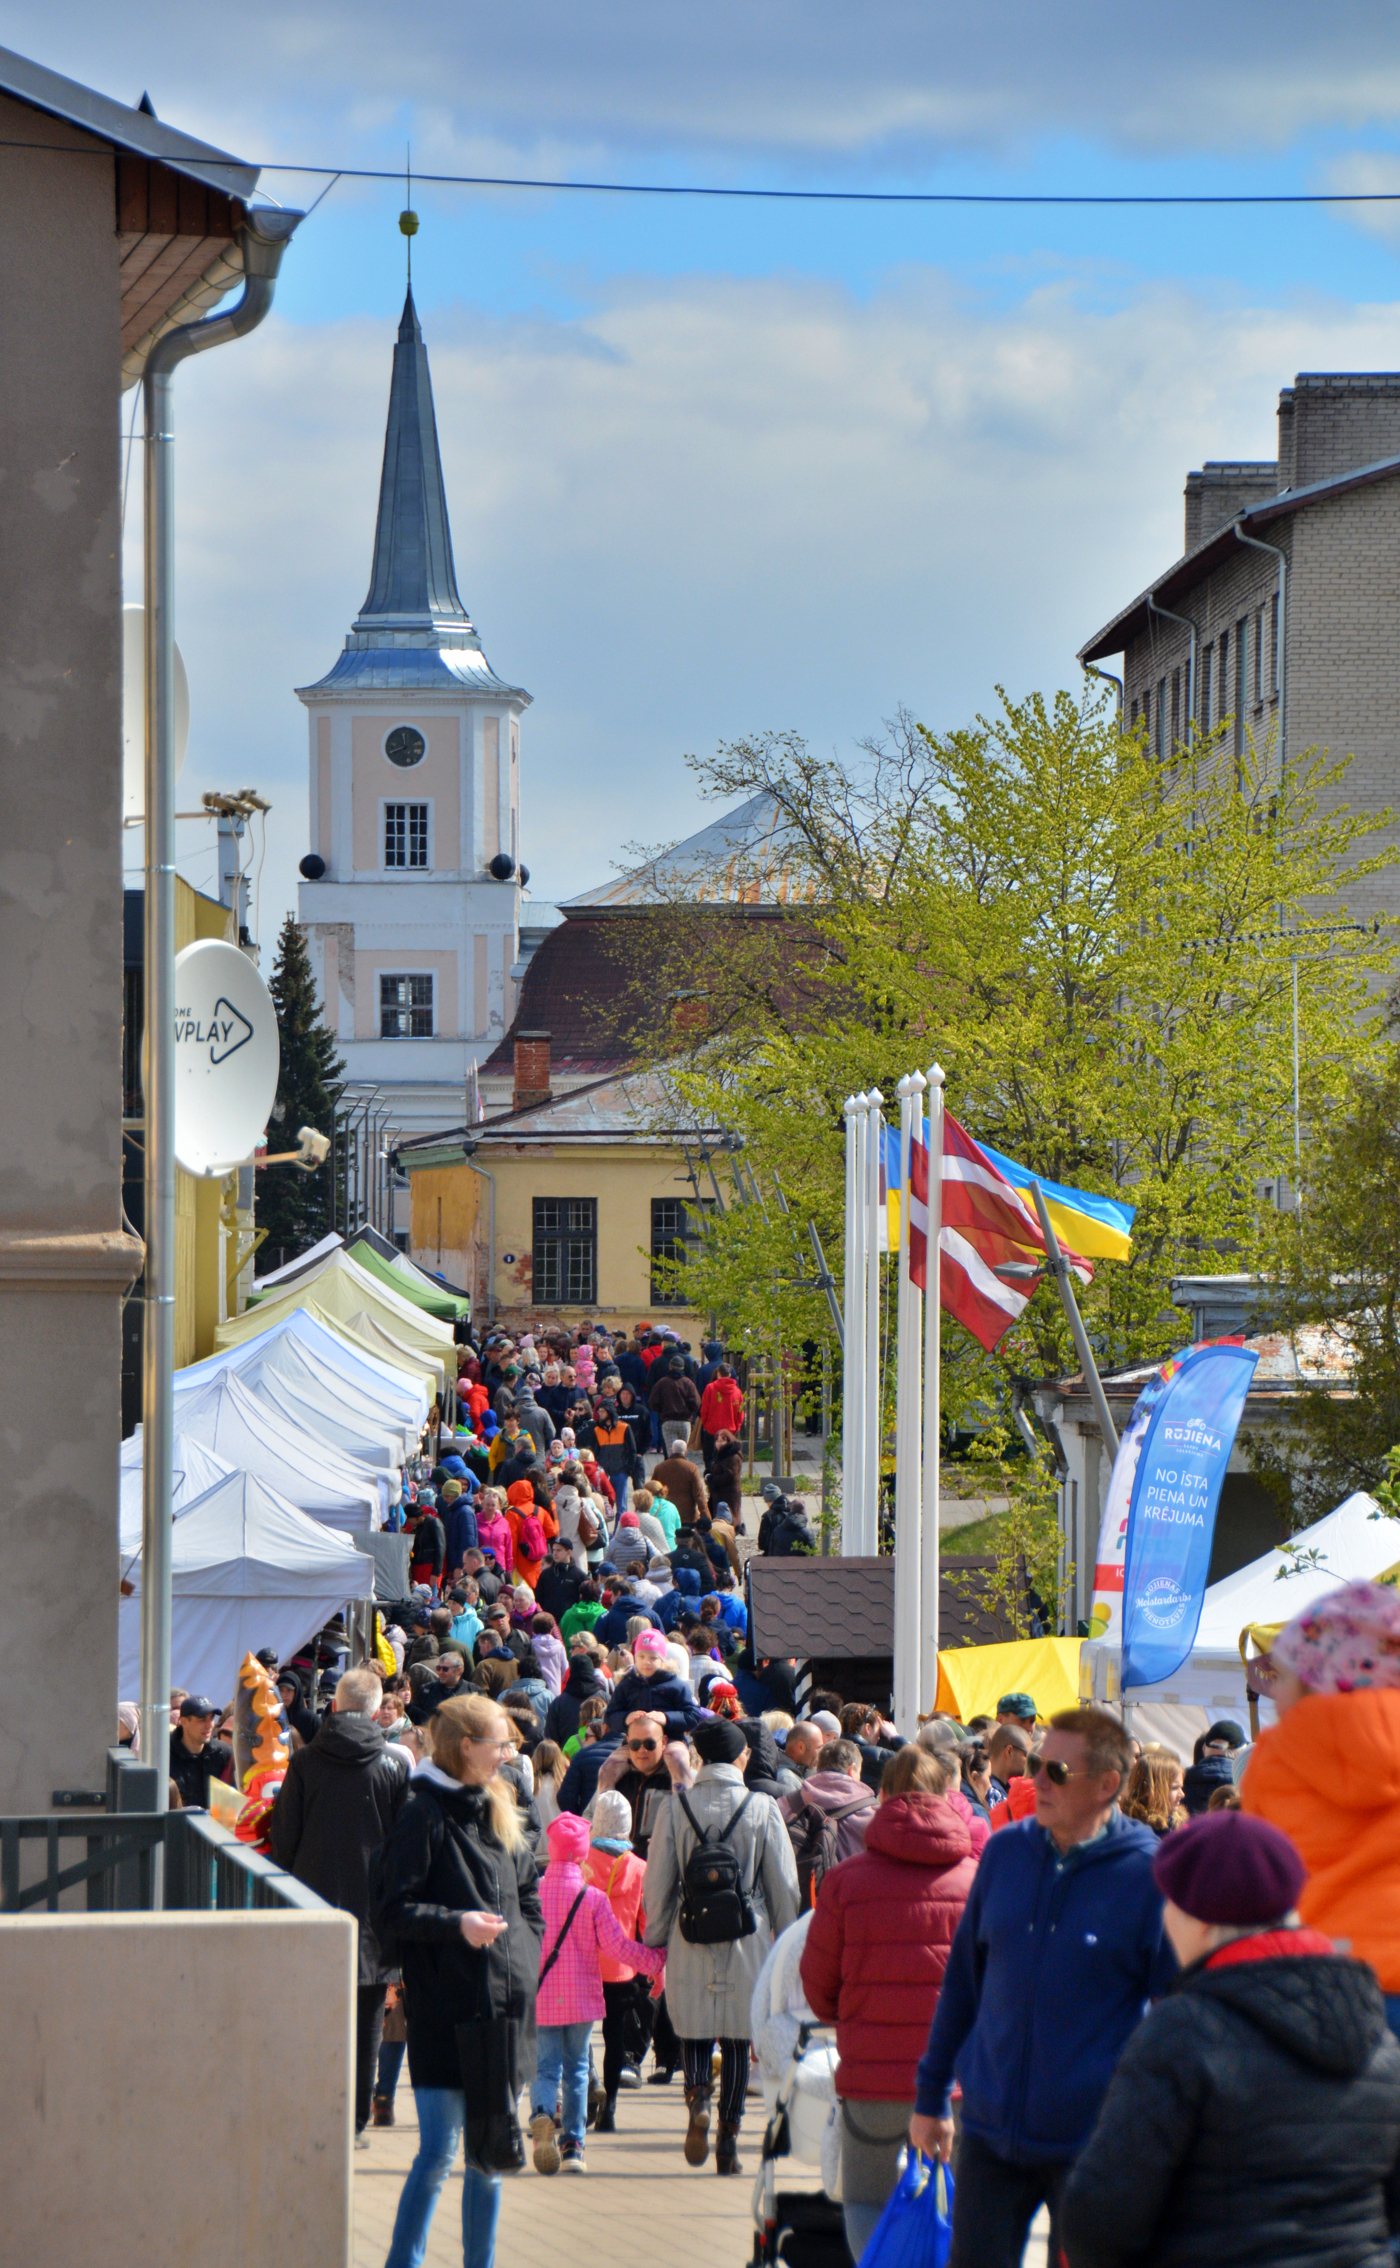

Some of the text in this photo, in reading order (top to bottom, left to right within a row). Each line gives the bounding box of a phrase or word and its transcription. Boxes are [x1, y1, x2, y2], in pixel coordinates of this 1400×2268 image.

[1165, 1428, 1221, 1450] RŪJIENA
[1156, 1468, 1208, 1490] NO ĪSTA
[1147, 1486, 1208, 1508] PIENA UN
[1145, 1505, 1204, 1527] KRĒJUMA
[1135, 1592, 1192, 1608] Meistardarbs
[1143, 1603, 1185, 1626] PIENOTAVAS
